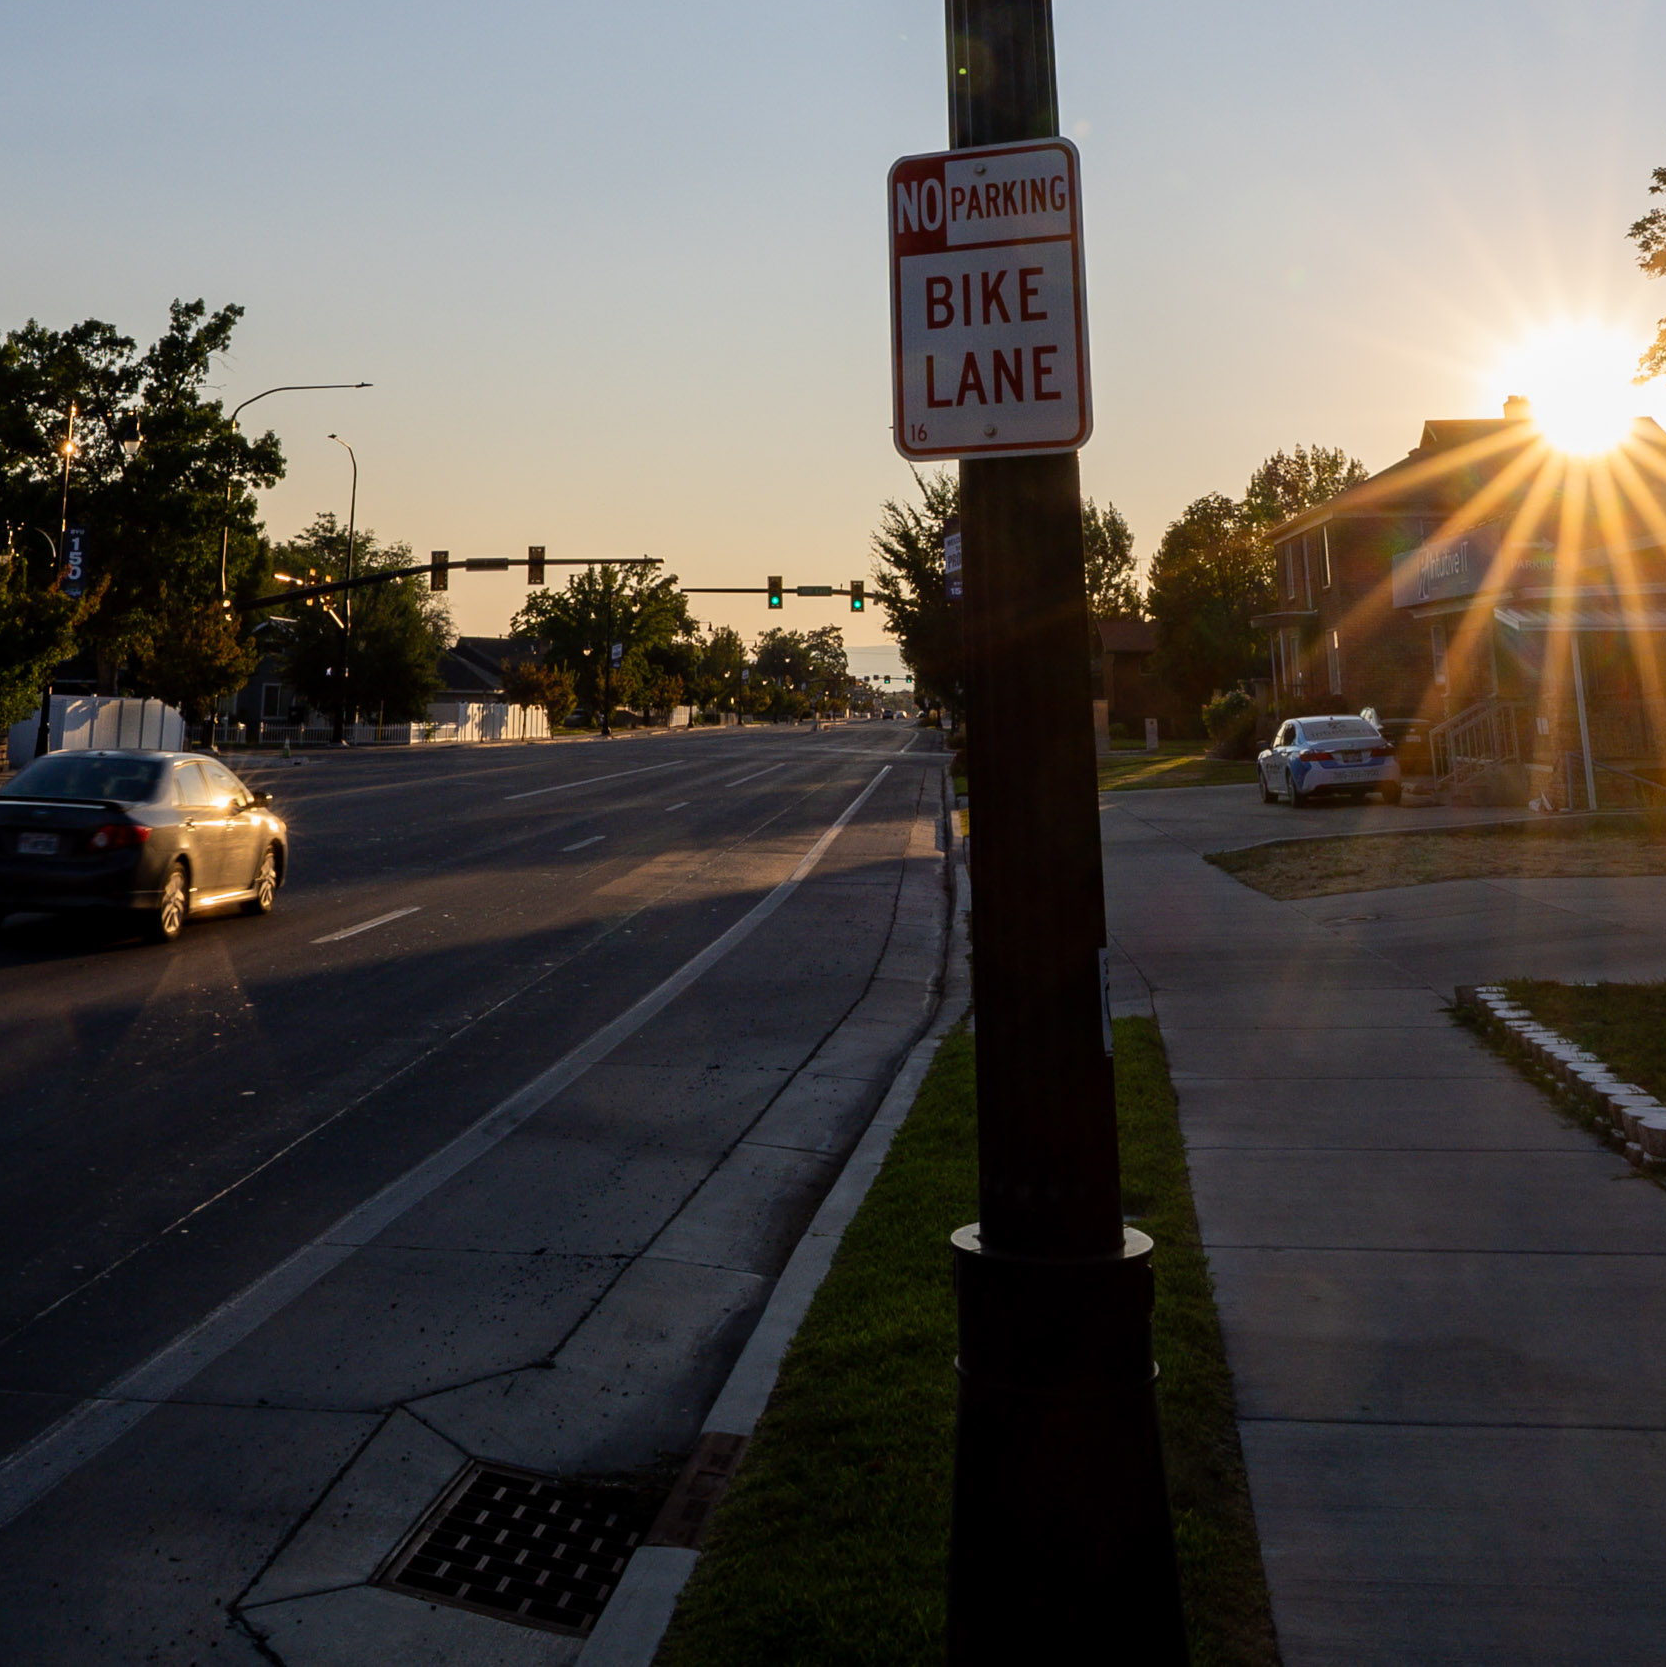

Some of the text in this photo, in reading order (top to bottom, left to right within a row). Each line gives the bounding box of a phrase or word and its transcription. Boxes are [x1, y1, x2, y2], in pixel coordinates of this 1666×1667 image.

[897, 175, 1066, 234] NO PARKING
[925, 266, 1048, 330] BIKE
[926, 345, 1062, 409] LANE
[911, 424, 928, 443] 16
